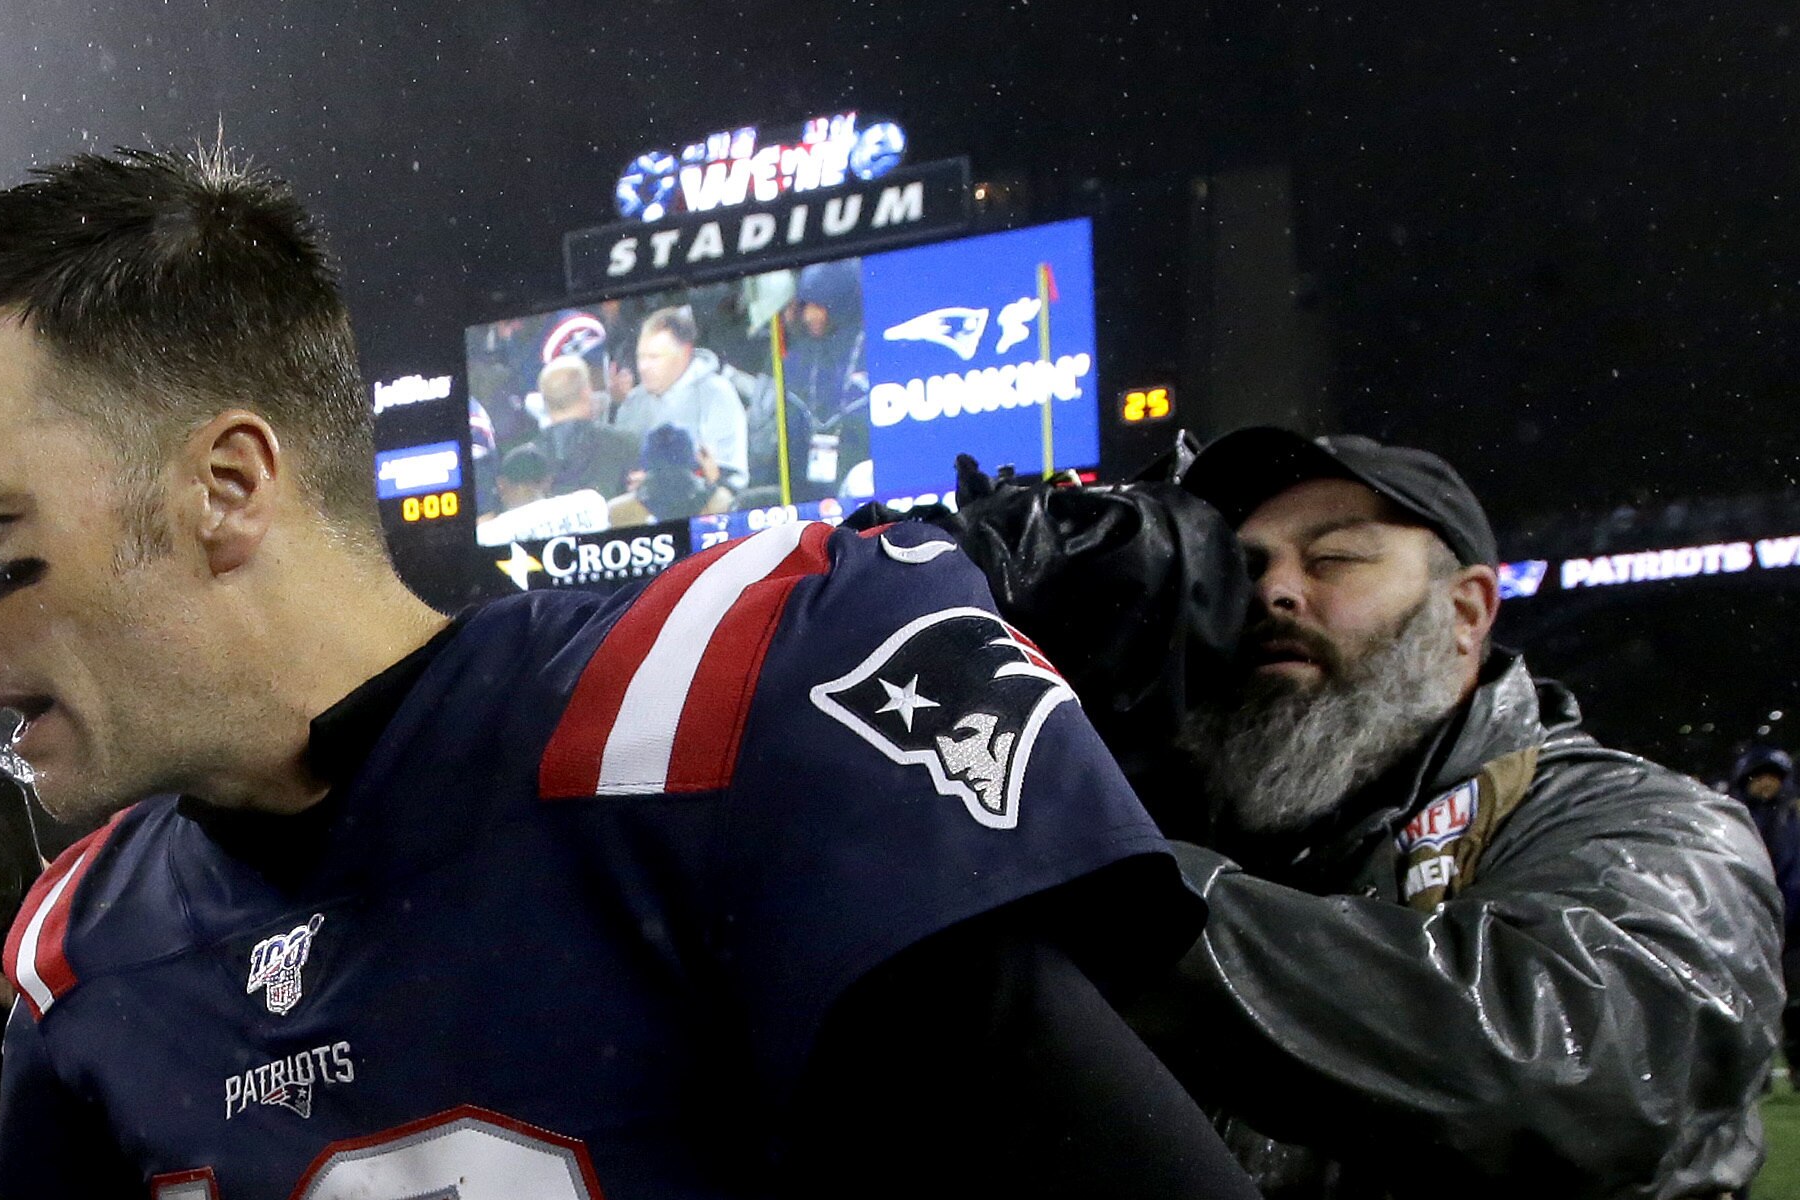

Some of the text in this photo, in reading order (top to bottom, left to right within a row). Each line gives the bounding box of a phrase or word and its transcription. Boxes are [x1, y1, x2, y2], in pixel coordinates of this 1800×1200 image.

[606, 182, 923, 277] STADIUM
[402, 491, 459, 522] 0:00
[542, 535, 675, 578] CROSS
[1560, 541, 1752, 590] PATRIOTS
[1406, 797, 1468, 840] NFL
[225, 1041, 354, 1120] PATRIOTS
